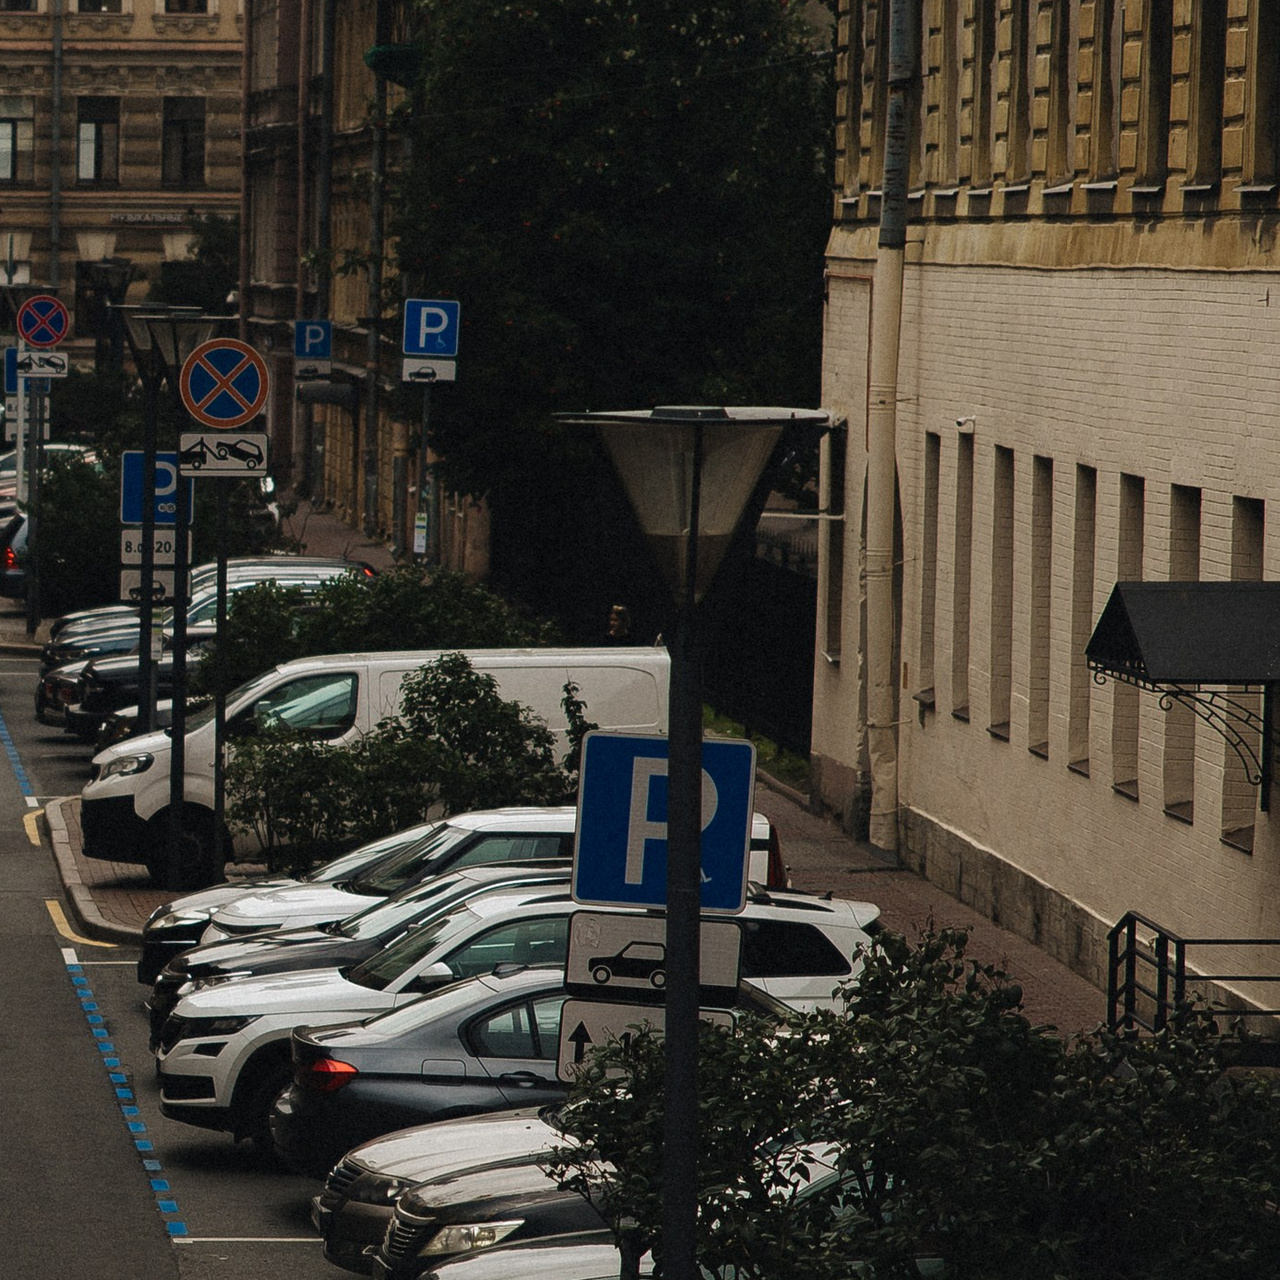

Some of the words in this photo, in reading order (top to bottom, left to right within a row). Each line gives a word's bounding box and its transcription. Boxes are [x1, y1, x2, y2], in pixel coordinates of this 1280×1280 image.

[305, 325, 325, 353] P
[418, 306, 449, 348] P
[624, 756, 718, 885] P
